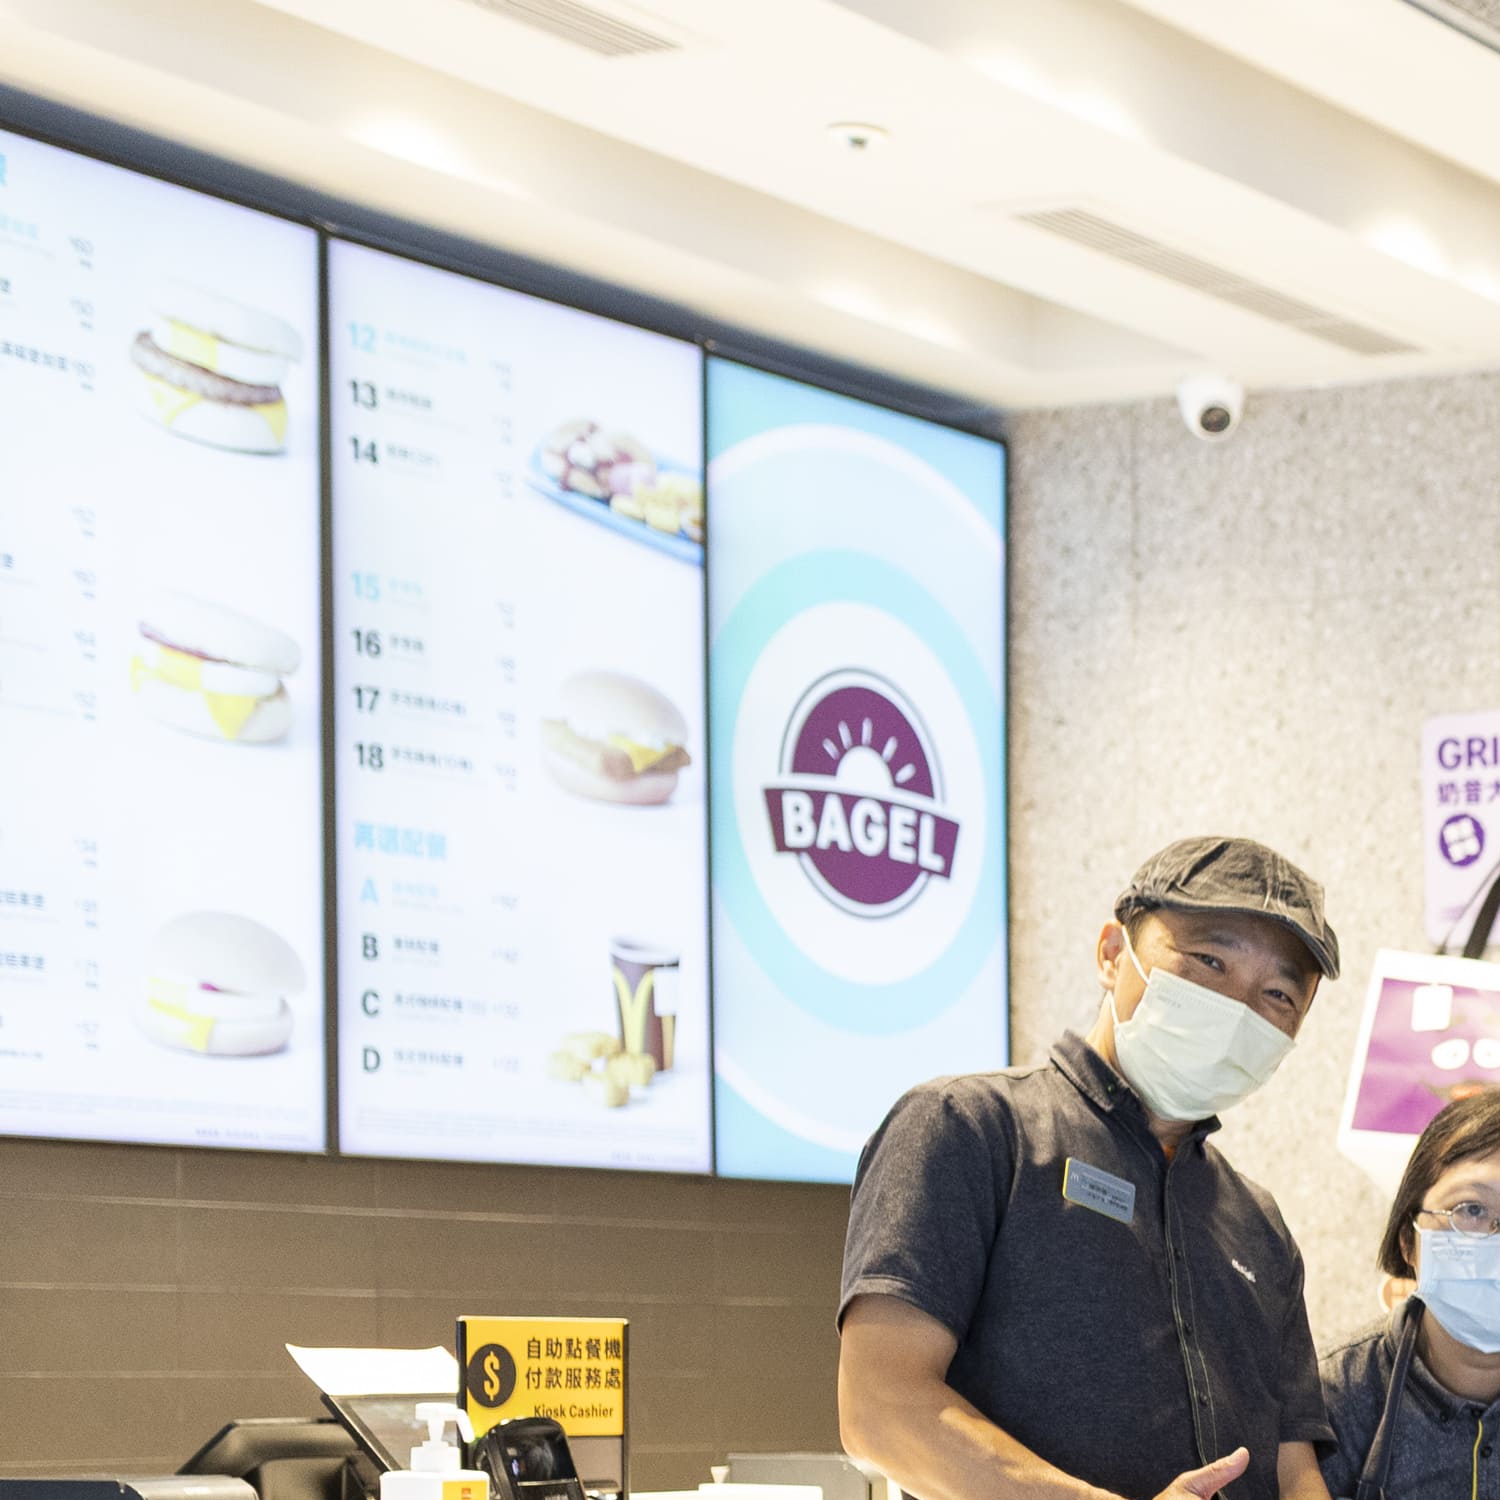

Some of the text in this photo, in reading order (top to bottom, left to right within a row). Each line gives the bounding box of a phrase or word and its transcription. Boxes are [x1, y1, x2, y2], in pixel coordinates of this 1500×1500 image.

[347, 320, 377, 352] 12
[348, 377, 379, 411] 13
[349, 433, 380, 466] 14
[350, 569, 381, 600] 15
[351, 626, 382, 658] 16
[352, 683, 381, 714] 17
[353, 741, 384, 771] 18
[781, 788, 945, 871] BAGEL
[360, 876, 380, 905] A
[361, 931, 380, 962] B
[361, 988, 381, 1018] C
[362, 1045, 382, 1075] D
[526, 1336, 622, 1361] 自助點餐機
[525, 1366, 622, 1391] 付款服務處
[533, 1404, 614, 1419] Kiosk Cashier
